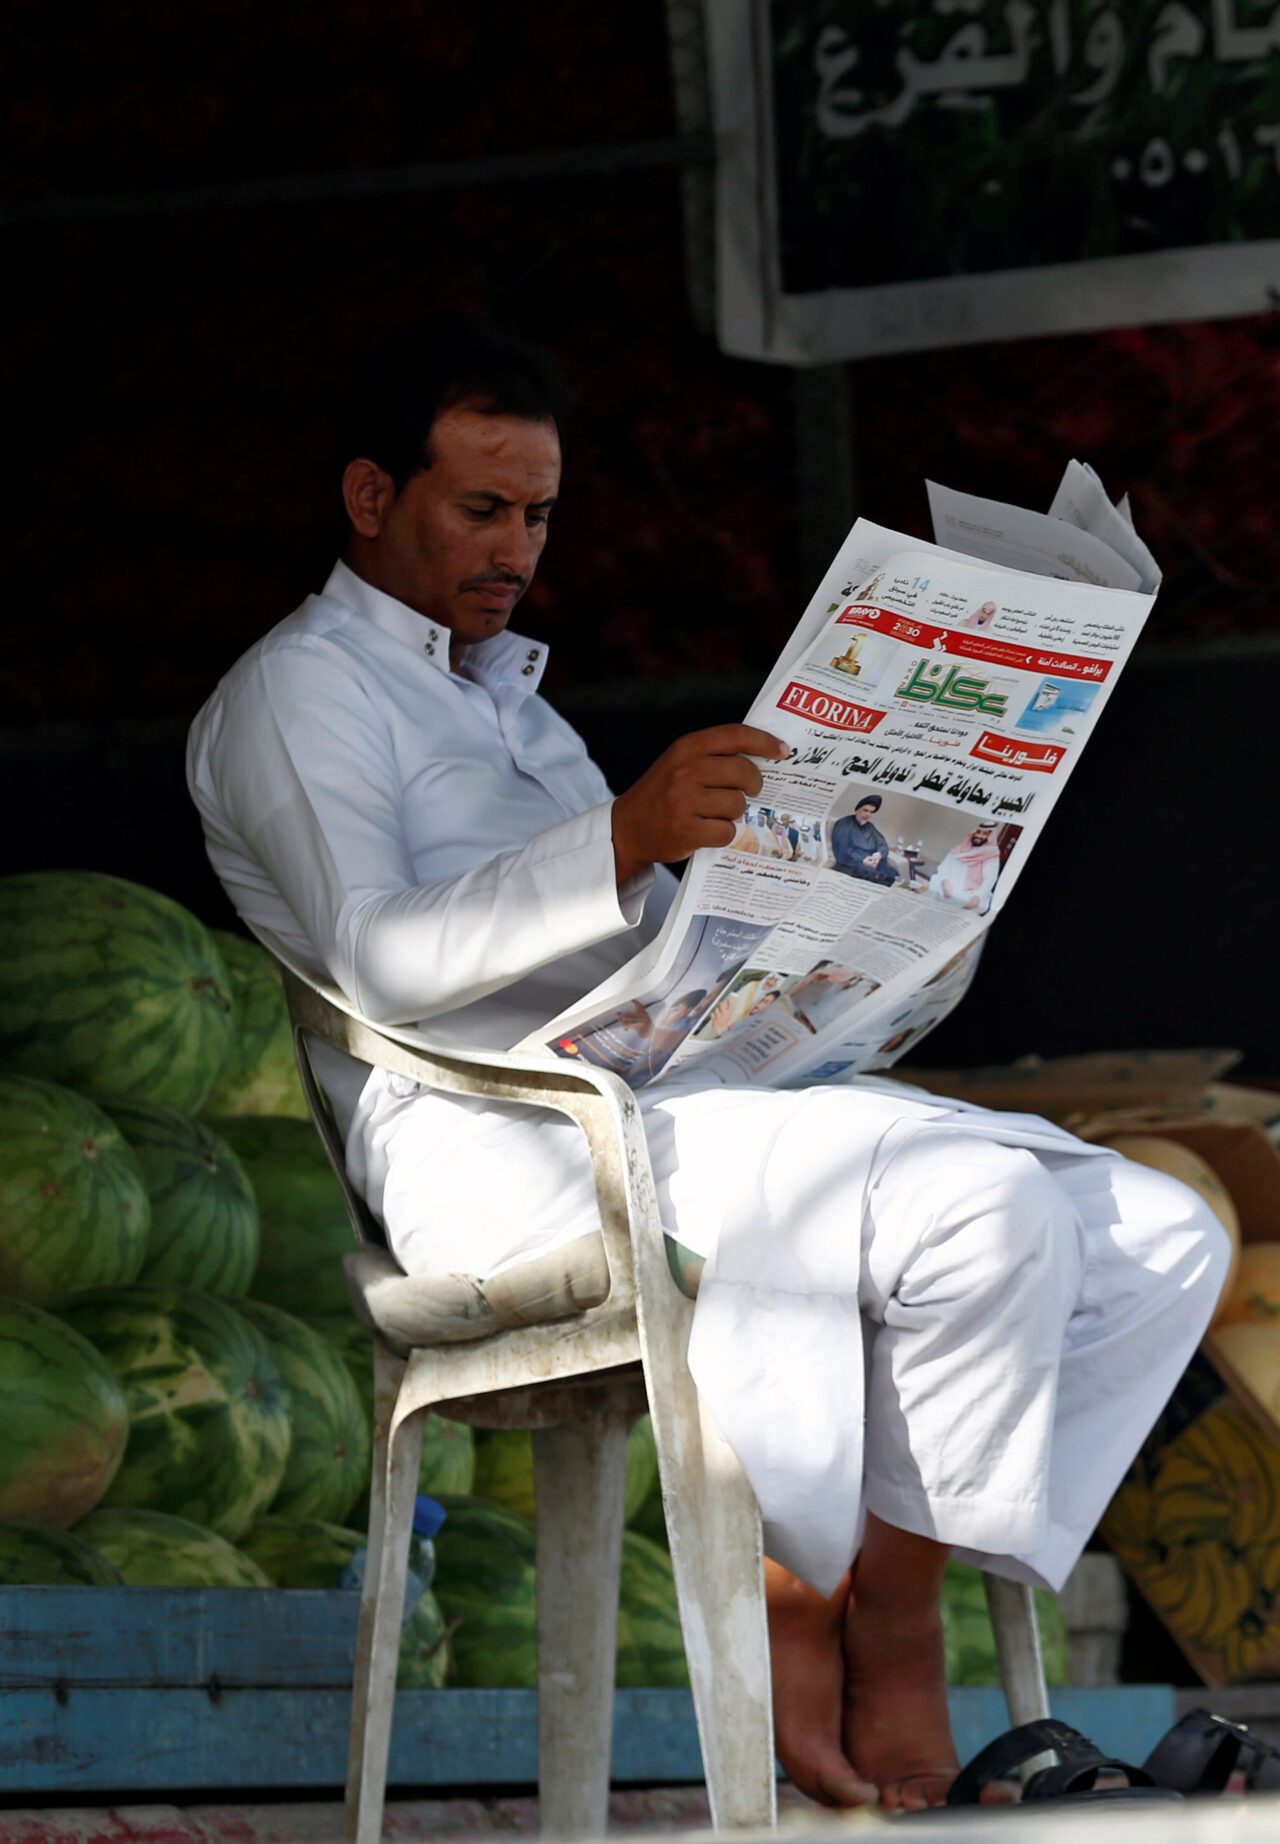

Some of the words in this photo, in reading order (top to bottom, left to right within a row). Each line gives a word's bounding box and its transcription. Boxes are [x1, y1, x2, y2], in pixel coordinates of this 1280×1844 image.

[912, 576, 930, 592] 14
[893, 658, 1009, 718] عكاظ
[785, 686, 875, 728] FLORINA
[792, 747, 836, 769] إعلان
[979, 735, 1058, 765] فلورينا
[913, 768, 953, 791] قطر
[947, 775, 992, 805] محاولة
